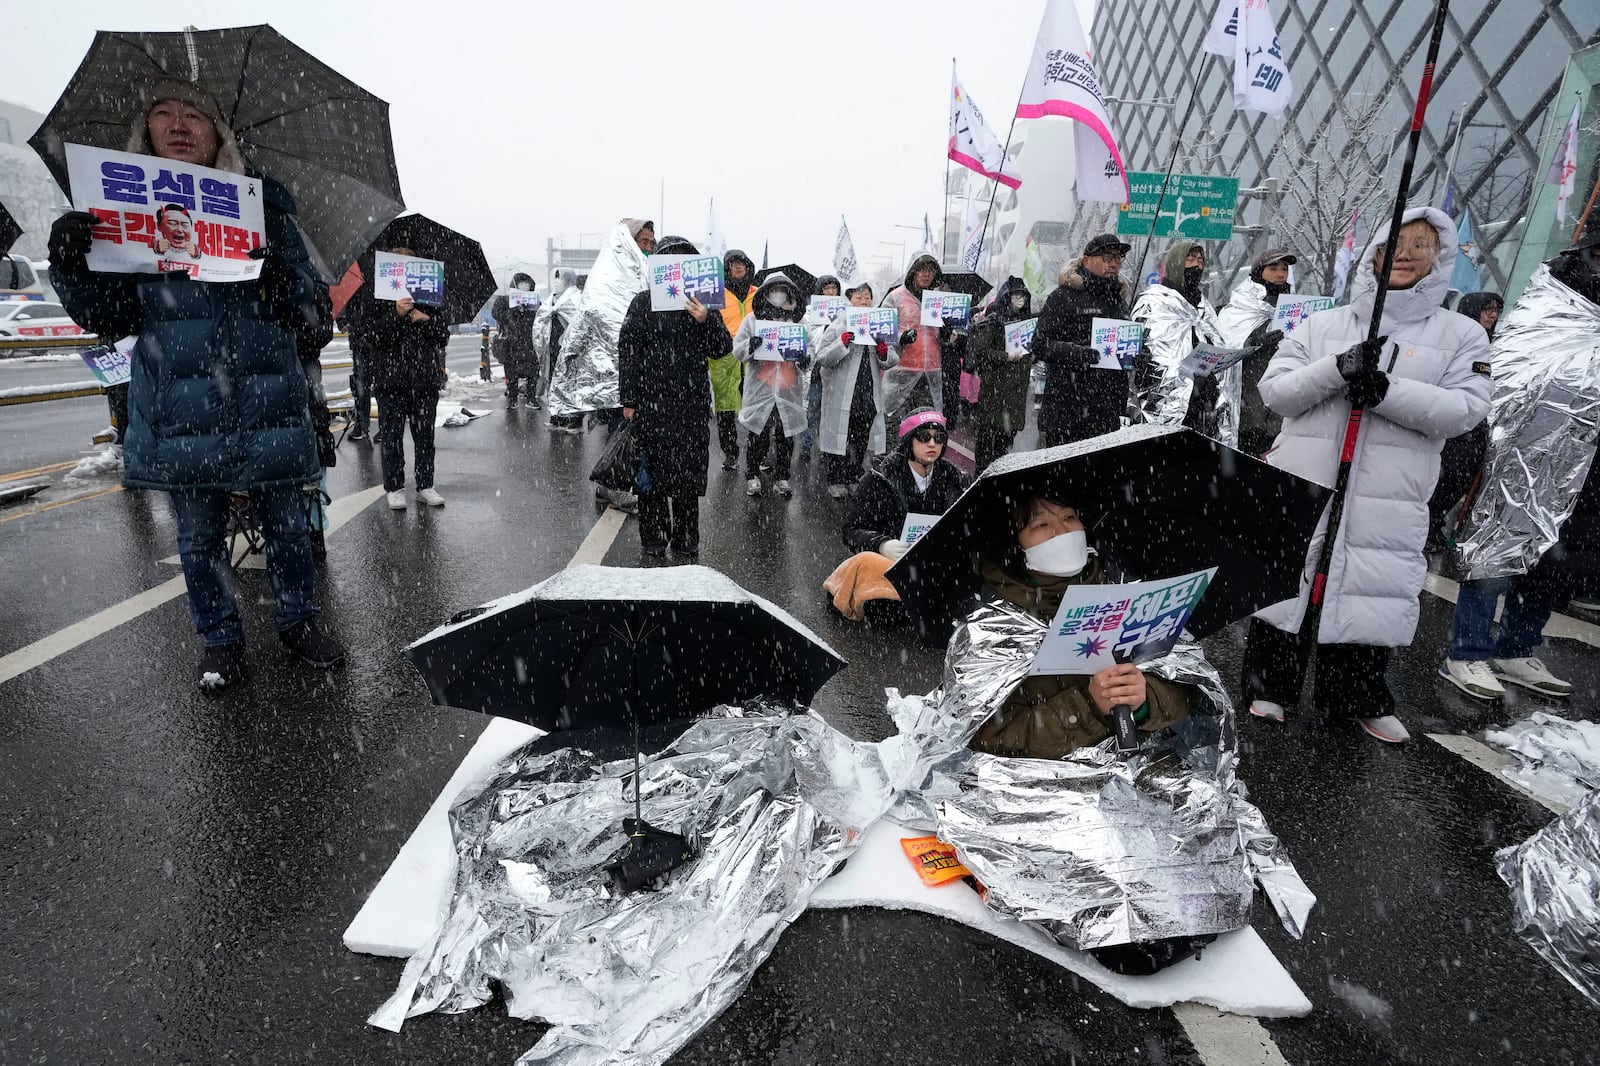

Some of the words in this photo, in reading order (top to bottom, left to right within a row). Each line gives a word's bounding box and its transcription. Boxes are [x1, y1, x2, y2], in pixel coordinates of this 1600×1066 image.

[100, 161, 241, 220] 윤석열
[1183, 180, 1196, 188] City
[88, 207, 156, 249] 즉각
[194, 219, 261, 261] 체포!
[1167, 230, 1185, 238] 600m
[406, 262, 438, 277] 체포!
[654, 263, 680, 274] 내란수괴
[683, 258, 718, 279] 체포!
[655, 271, 680, 284] 윤석열
[406, 278, 438, 293] 구속!
[684, 277, 719, 298] 구속!
[870, 311, 893, 324] 체포!
[779, 326, 803, 338] 체포!
[870, 324, 894, 338] 구속!
[1117, 326, 1140, 341] 체포!
[1095, 334, 1115, 344] 윤석열
[1066, 598, 1132, 620] 내란수괴
[1126, 577, 1202, 626] 체포!
[1058, 613, 1125, 636] 윤석열
[1115, 607, 1186, 658] 구속!
